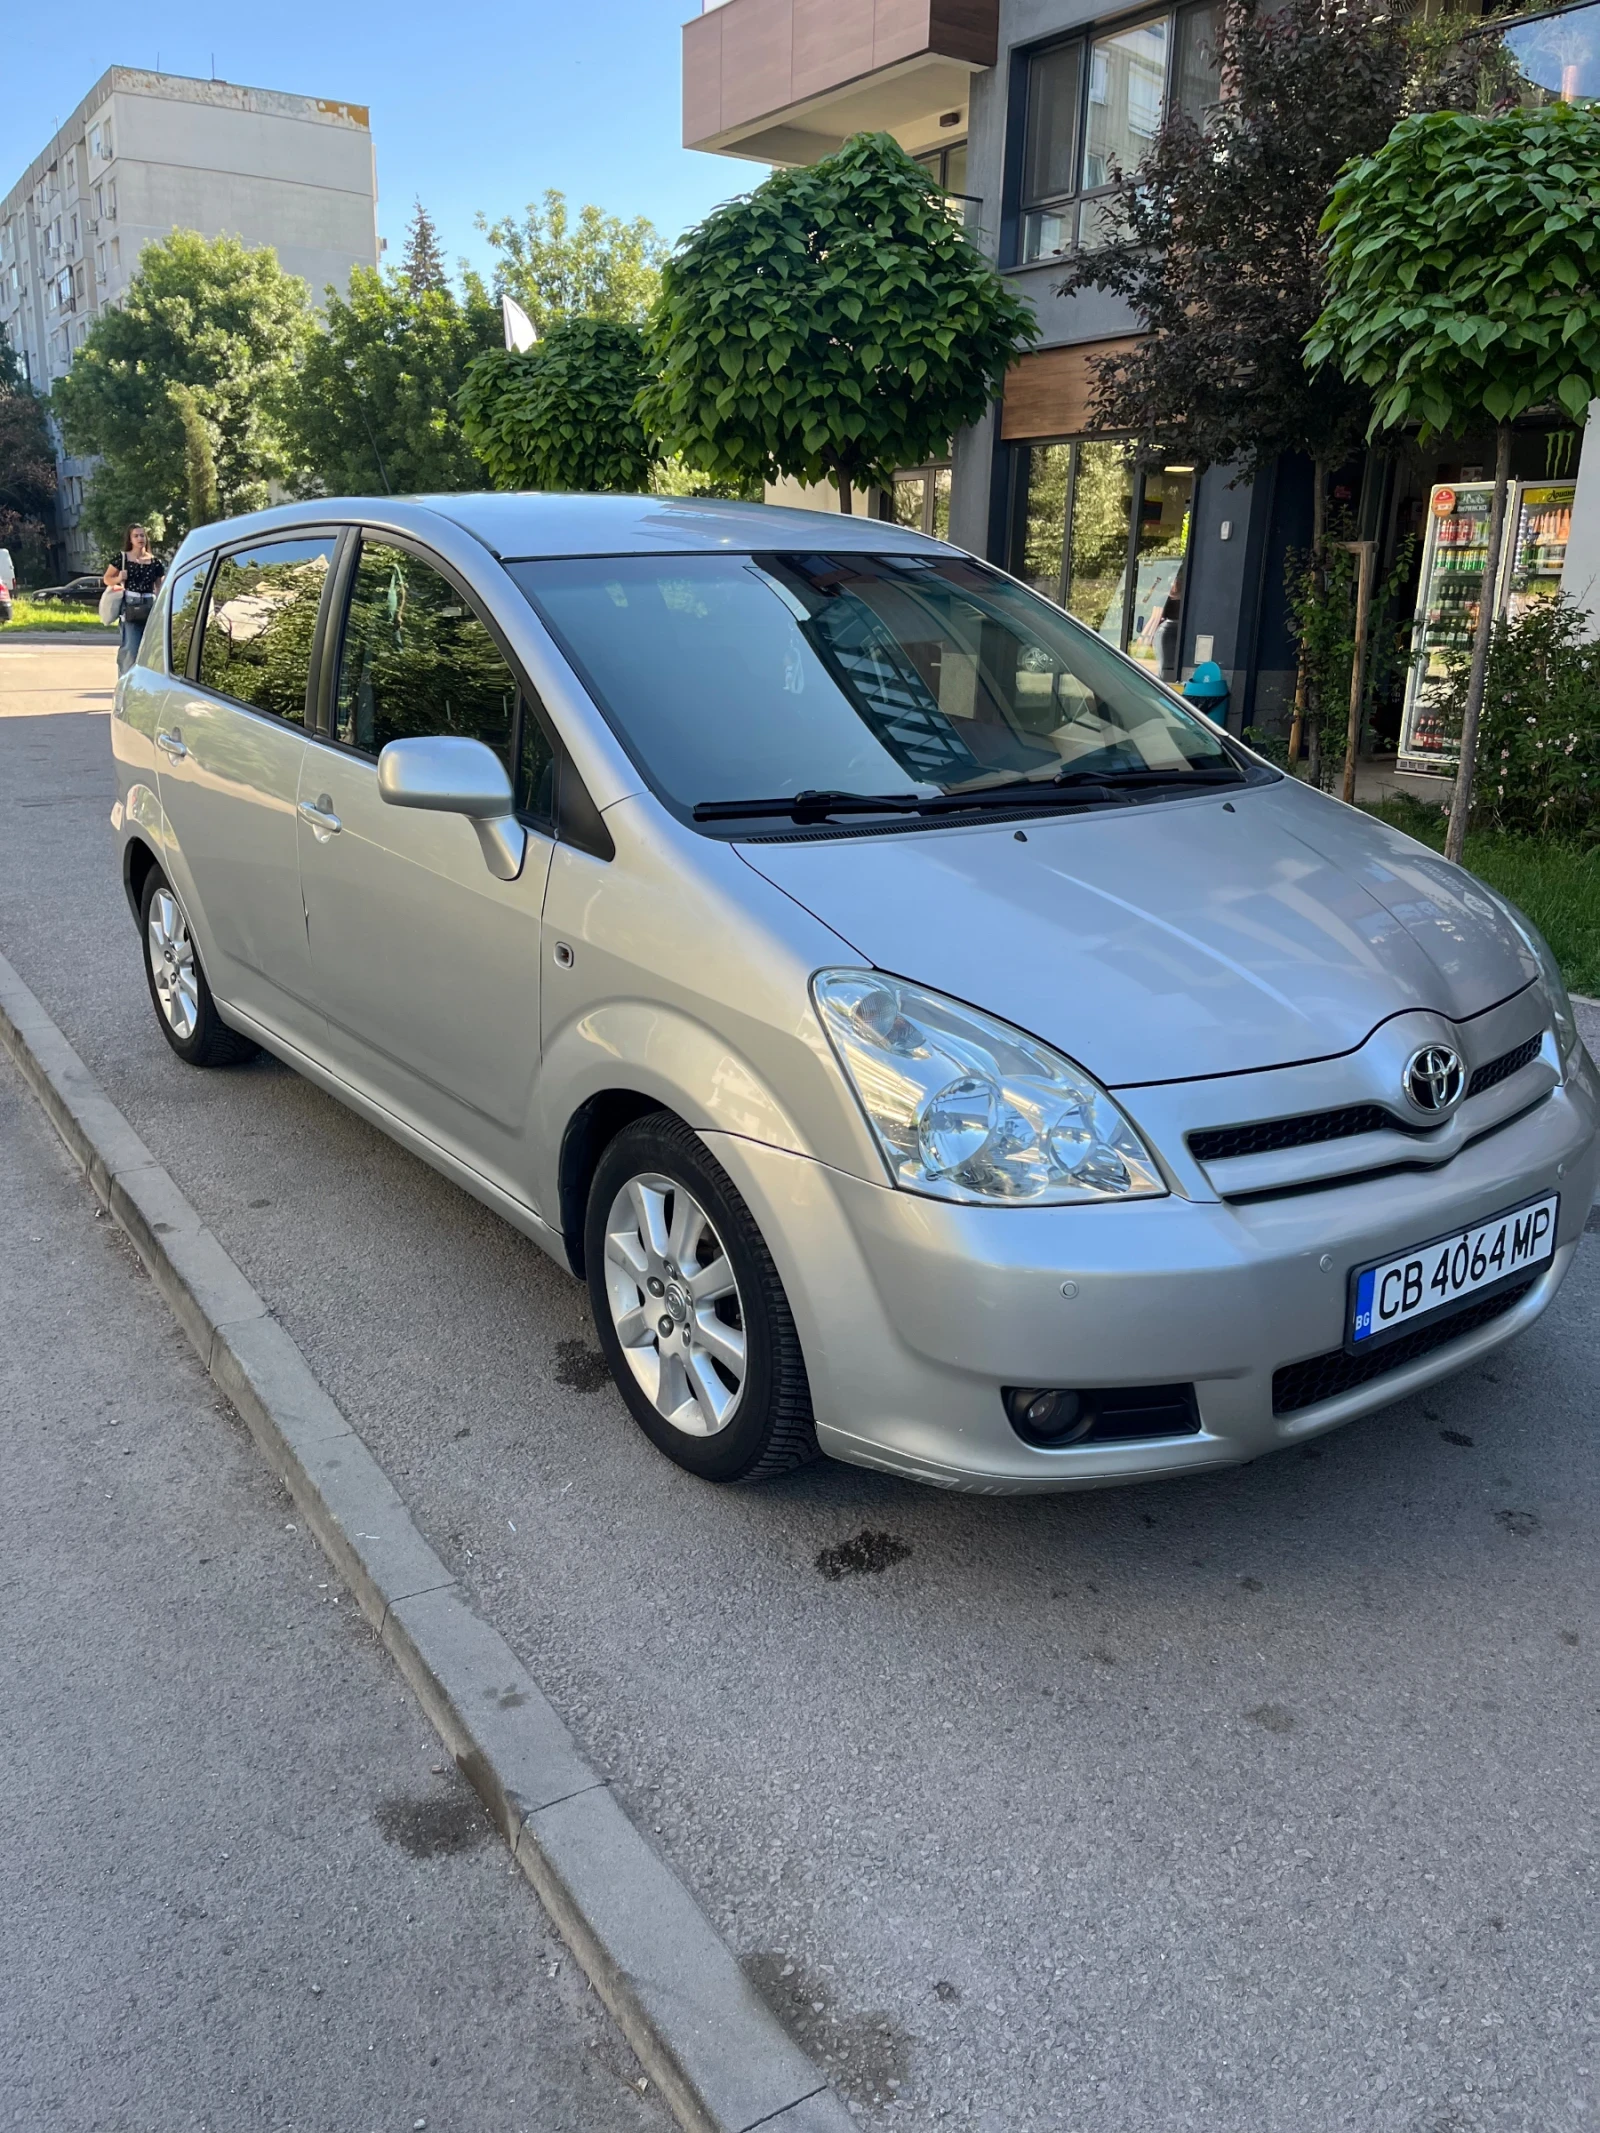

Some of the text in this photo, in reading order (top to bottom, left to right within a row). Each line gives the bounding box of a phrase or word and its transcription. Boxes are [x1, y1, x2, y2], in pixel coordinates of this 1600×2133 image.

[1379, 1207, 1550, 1320] CB 4064 MP
[1355, 1311, 1370, 1331] BG
